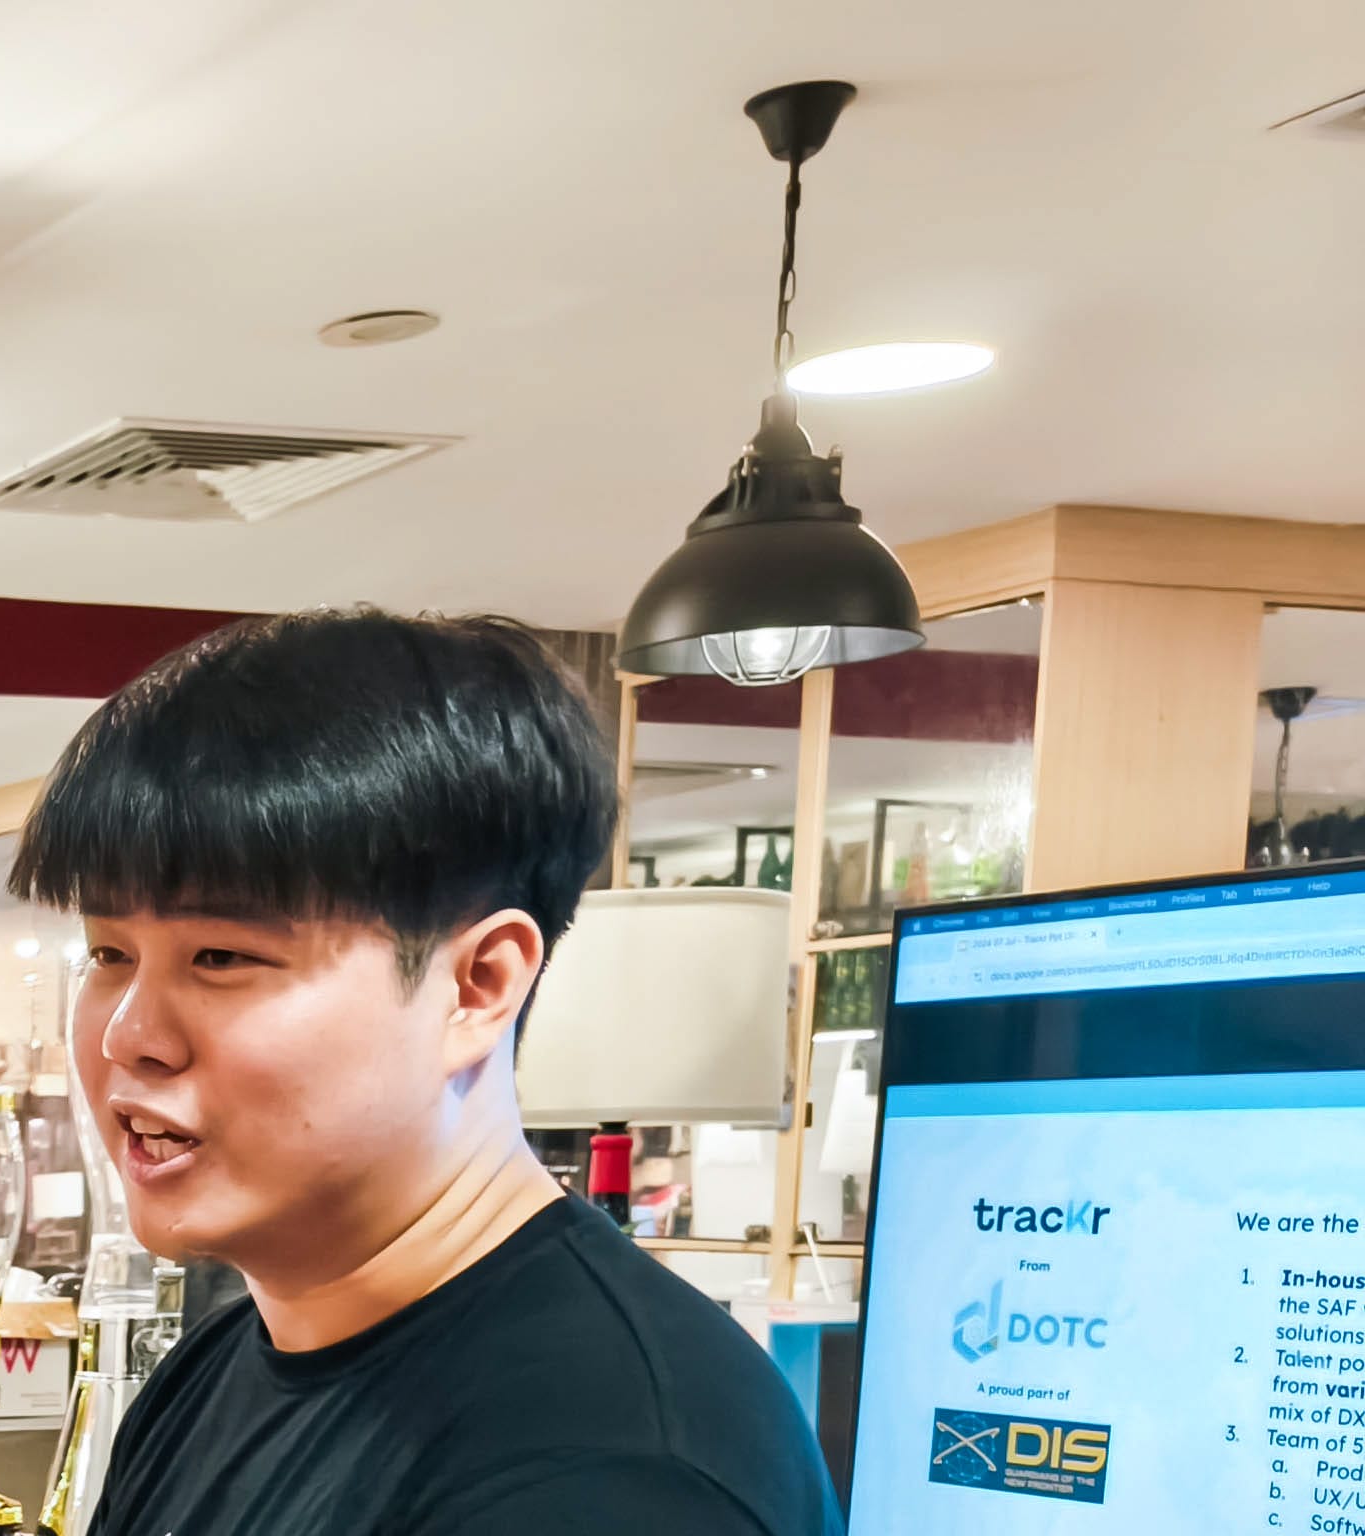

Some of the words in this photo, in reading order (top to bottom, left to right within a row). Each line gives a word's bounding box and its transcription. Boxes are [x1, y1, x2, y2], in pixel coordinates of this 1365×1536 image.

[1172, 893, 1205, 905] Profiles
[1221, 890, 1237, 901] Tab
[1253, 886, 1293, 897] Window
[1308, 881, 1331, 892] Help
[1237, 1212, 1270, 1231] We
[1278, 1217, 1314, 1232] are
[1323, 1213, 1359, 1233] the
[1019, 1260, 1050, 1272] From
[1242, 1268, 1254, 1285] 1.
[1280, 1296, 1309, 1313] the
[1317, 1298, 1356, 1316] SAF
[1008, 1314, 1108, 1348] DOTC
[1276, 1324, 1364, 1344] solutions
[1234, 1346, 1247, 1363] 2.
[1276, 1349, 1332, 1368] Talent
[977, 1383, 984, 1393] A
[988, 1383, 1023, 1398] proud
[1028, 1385, 1053, 1401] part
[1057, 1389, 1070, 1400] of
[1273, 1376, 1318, 1395] from
[1270, 1403, 1304, 1421] mix
[1311, 1407, 1332, 1424] of
[1006, 1422, 1108, 1474] DIS
[1226, 1425, 1239, 1441] 3.
[1268, 1429, 1318, 1450] Team
[1326, 1436, 1347, 1452] of
[1272, 1459, 1288, 1473] a.
[1317, 1461, 1363, 1481] Prod
[1269, 1482, 1285, 1500] b.
[1268, 1513, 1282, 1527] c.
